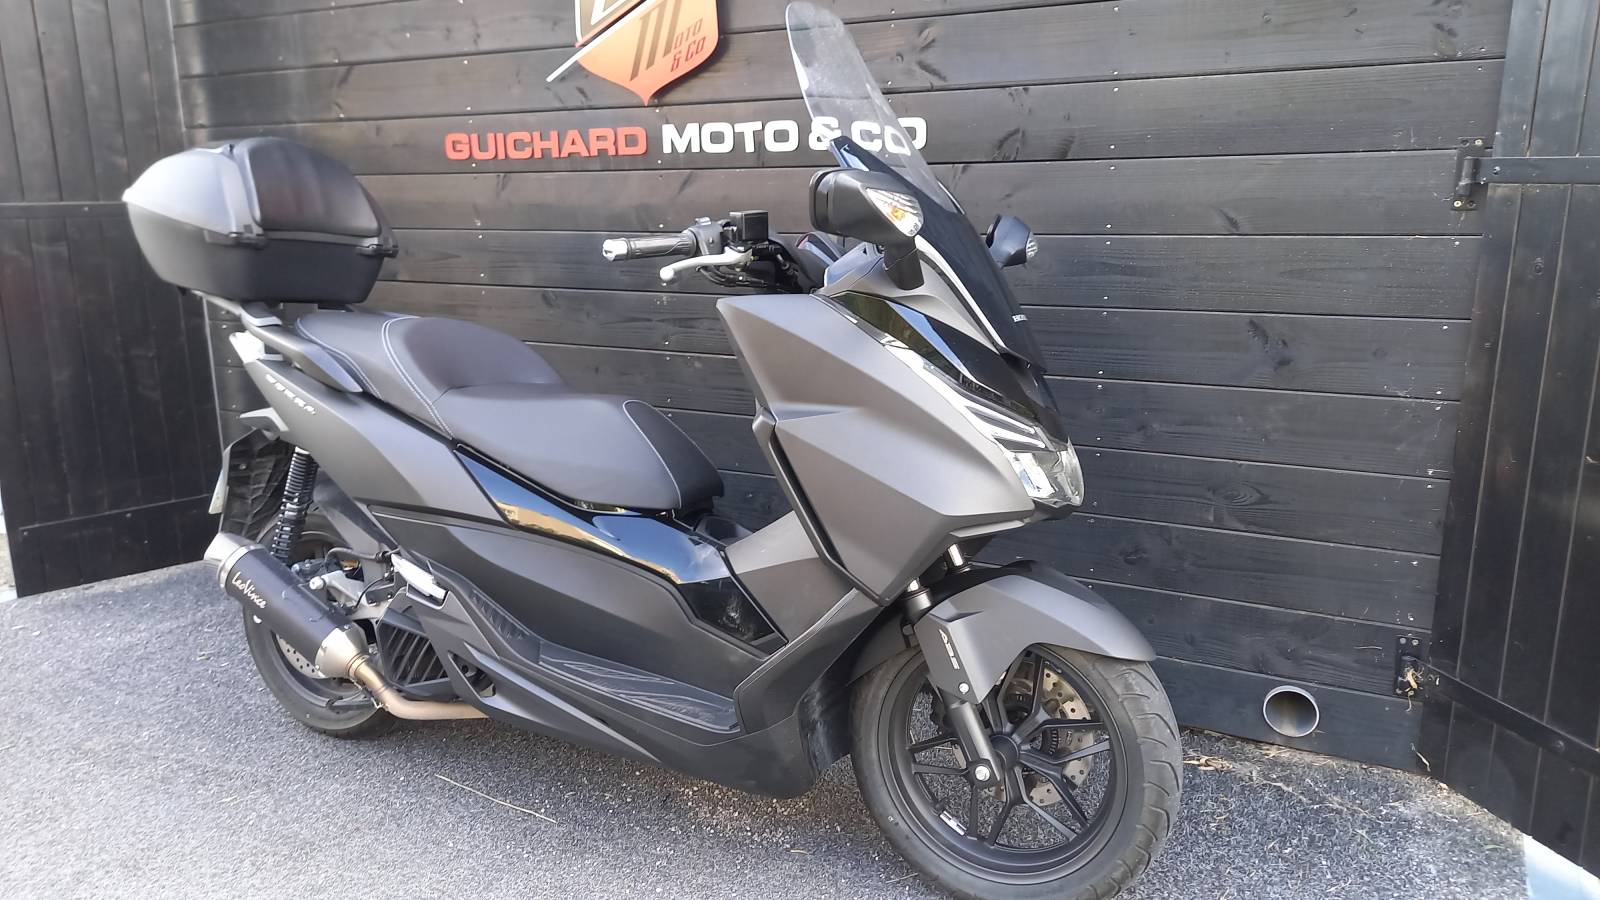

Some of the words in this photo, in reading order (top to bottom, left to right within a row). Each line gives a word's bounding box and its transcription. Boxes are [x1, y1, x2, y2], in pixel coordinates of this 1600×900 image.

[445, 126, 648, 160] GUICHARD
[661, 119, 799, 153] MOTO
[808, 116, 842, 151] &
[851, 116, 927, 156] CO
